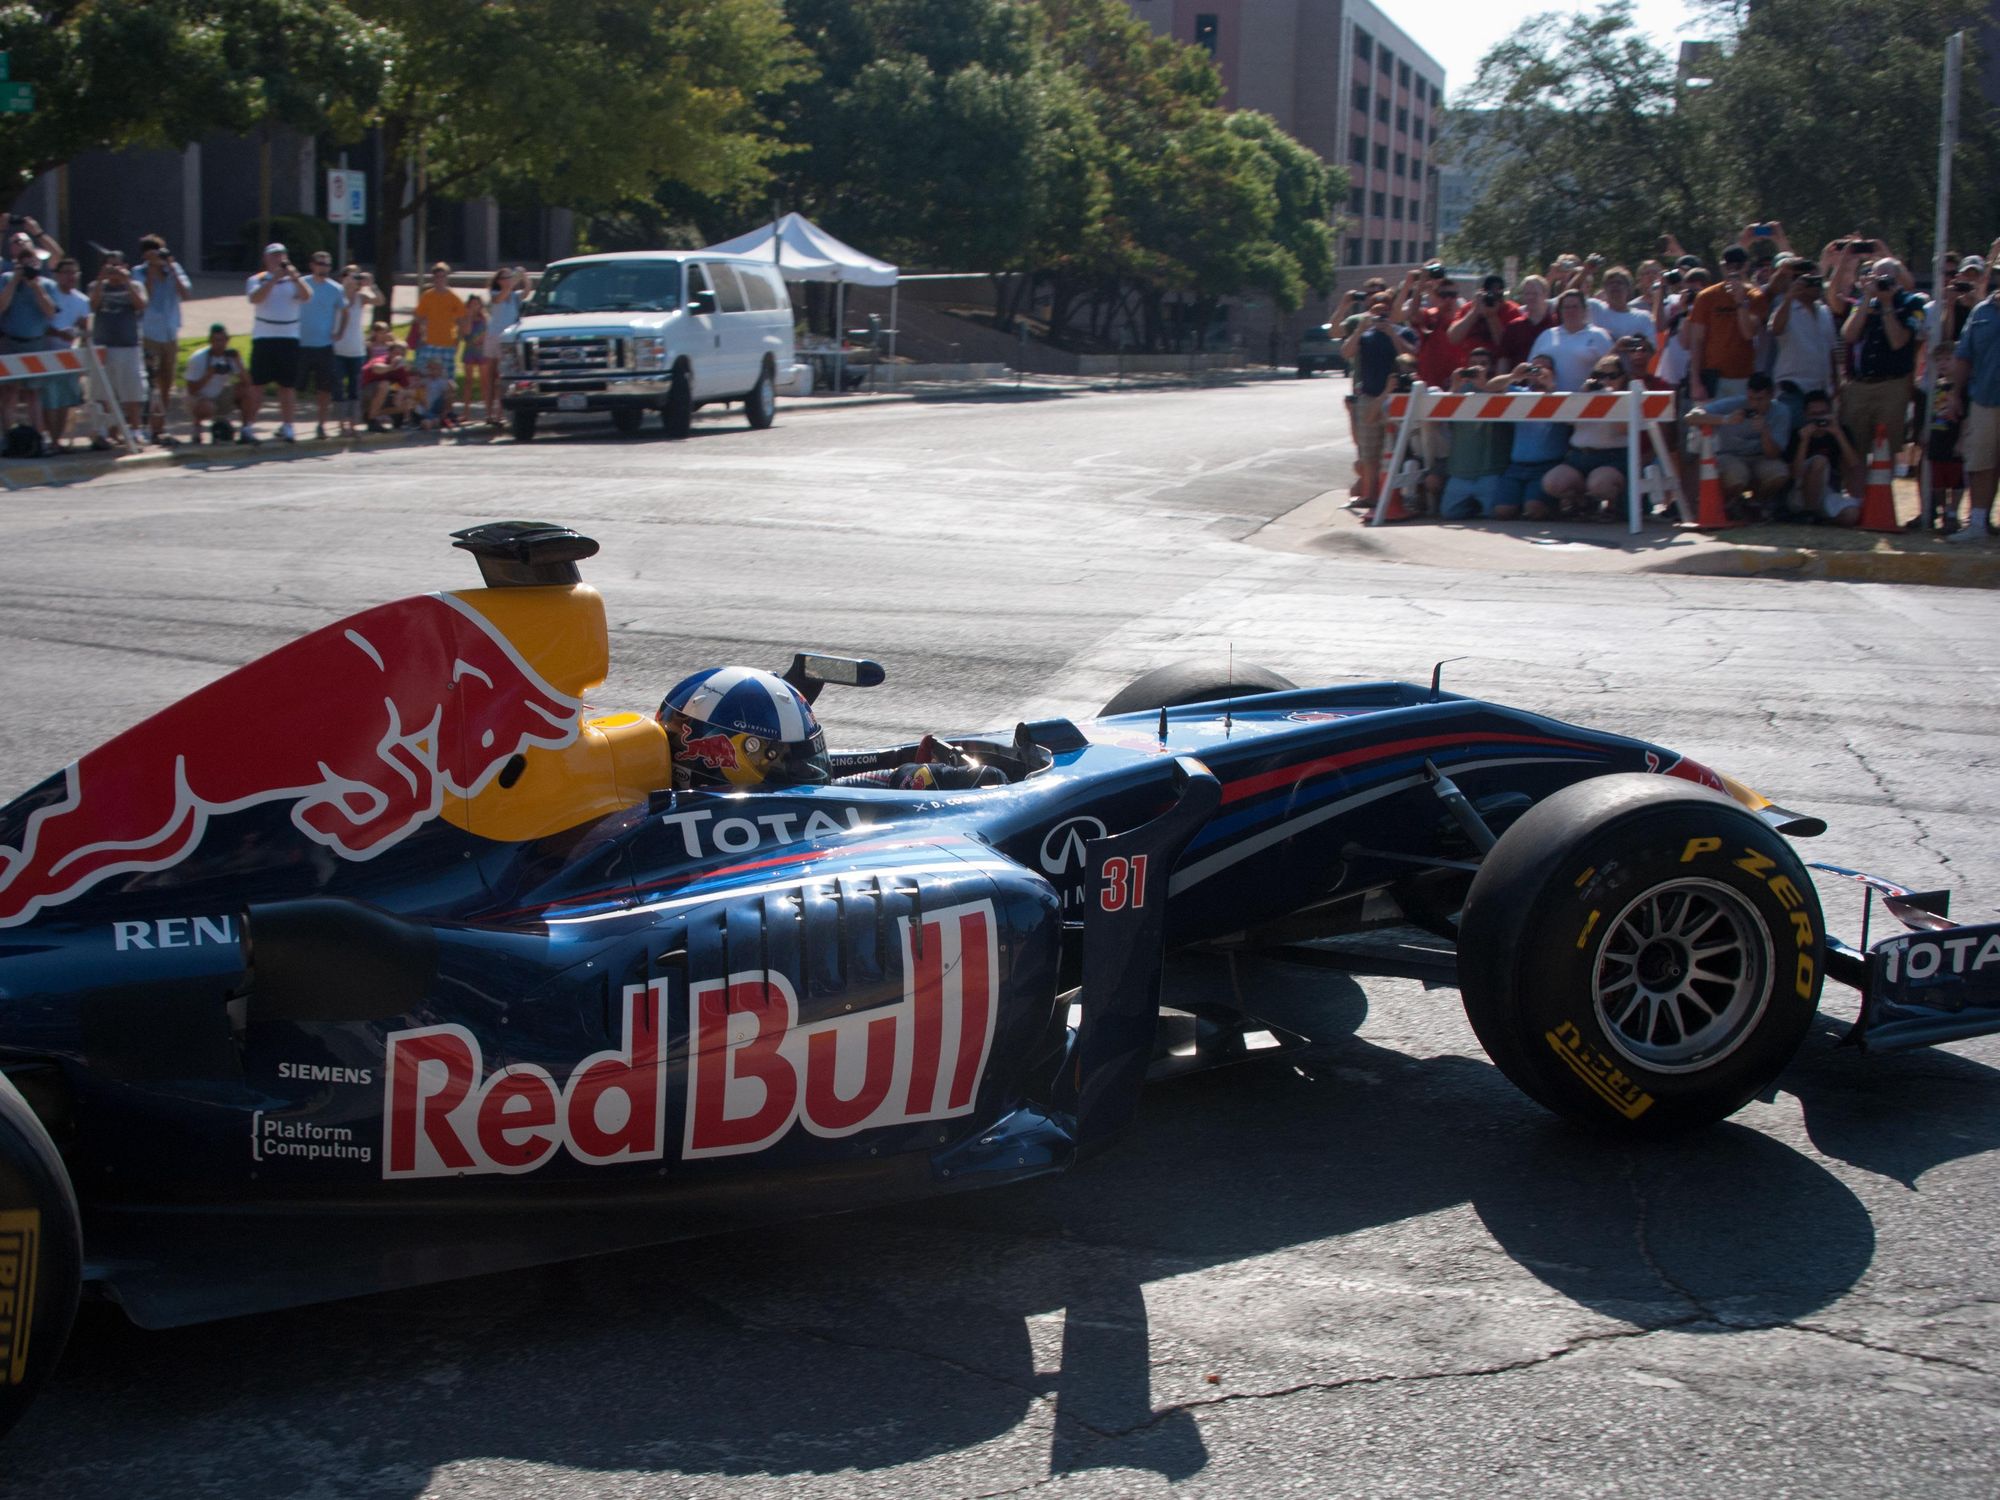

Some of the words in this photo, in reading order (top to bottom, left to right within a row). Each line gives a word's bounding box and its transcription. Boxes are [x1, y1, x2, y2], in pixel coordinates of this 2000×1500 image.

[1100, 854, 1148, 912] 31
[112, 914, 240, 951] REN
[1679, 836, 1723, 863] P
[1732, 847, 1814, 1000] ZERO
[382, 977, 669, 1180] Red
[682, 898, 999, 1160] Bull
[278, 1062, 373, 1085] SIEMENS
[1545, 1020, 1655, 1120] PIRELI
[263, 1139, 372, 1163] Computing
[264, 1120, 353, 1141] Platform
